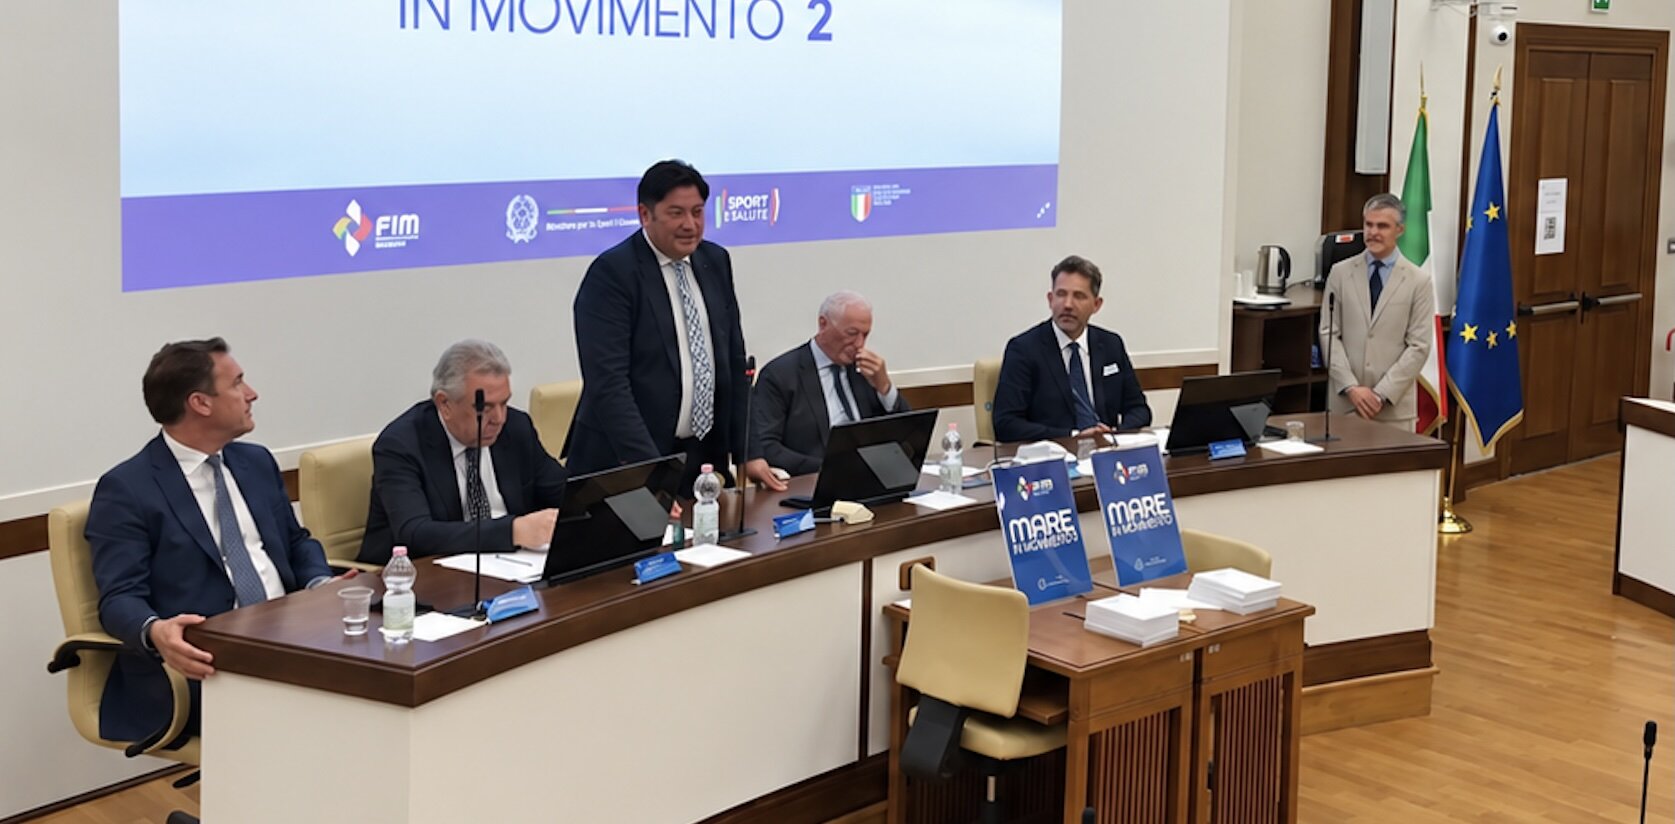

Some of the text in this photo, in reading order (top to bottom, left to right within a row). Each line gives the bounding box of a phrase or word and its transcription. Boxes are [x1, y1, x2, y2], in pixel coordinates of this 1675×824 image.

[399, 0, 832, 41] IN MOVIMENTO 2
[728, 194, 769, 210] SPORT
[375, 213, 420, 236] FIM
[1107, 493, 1170, 525] MARE
[1009, 508, 1075, 543] MARE
